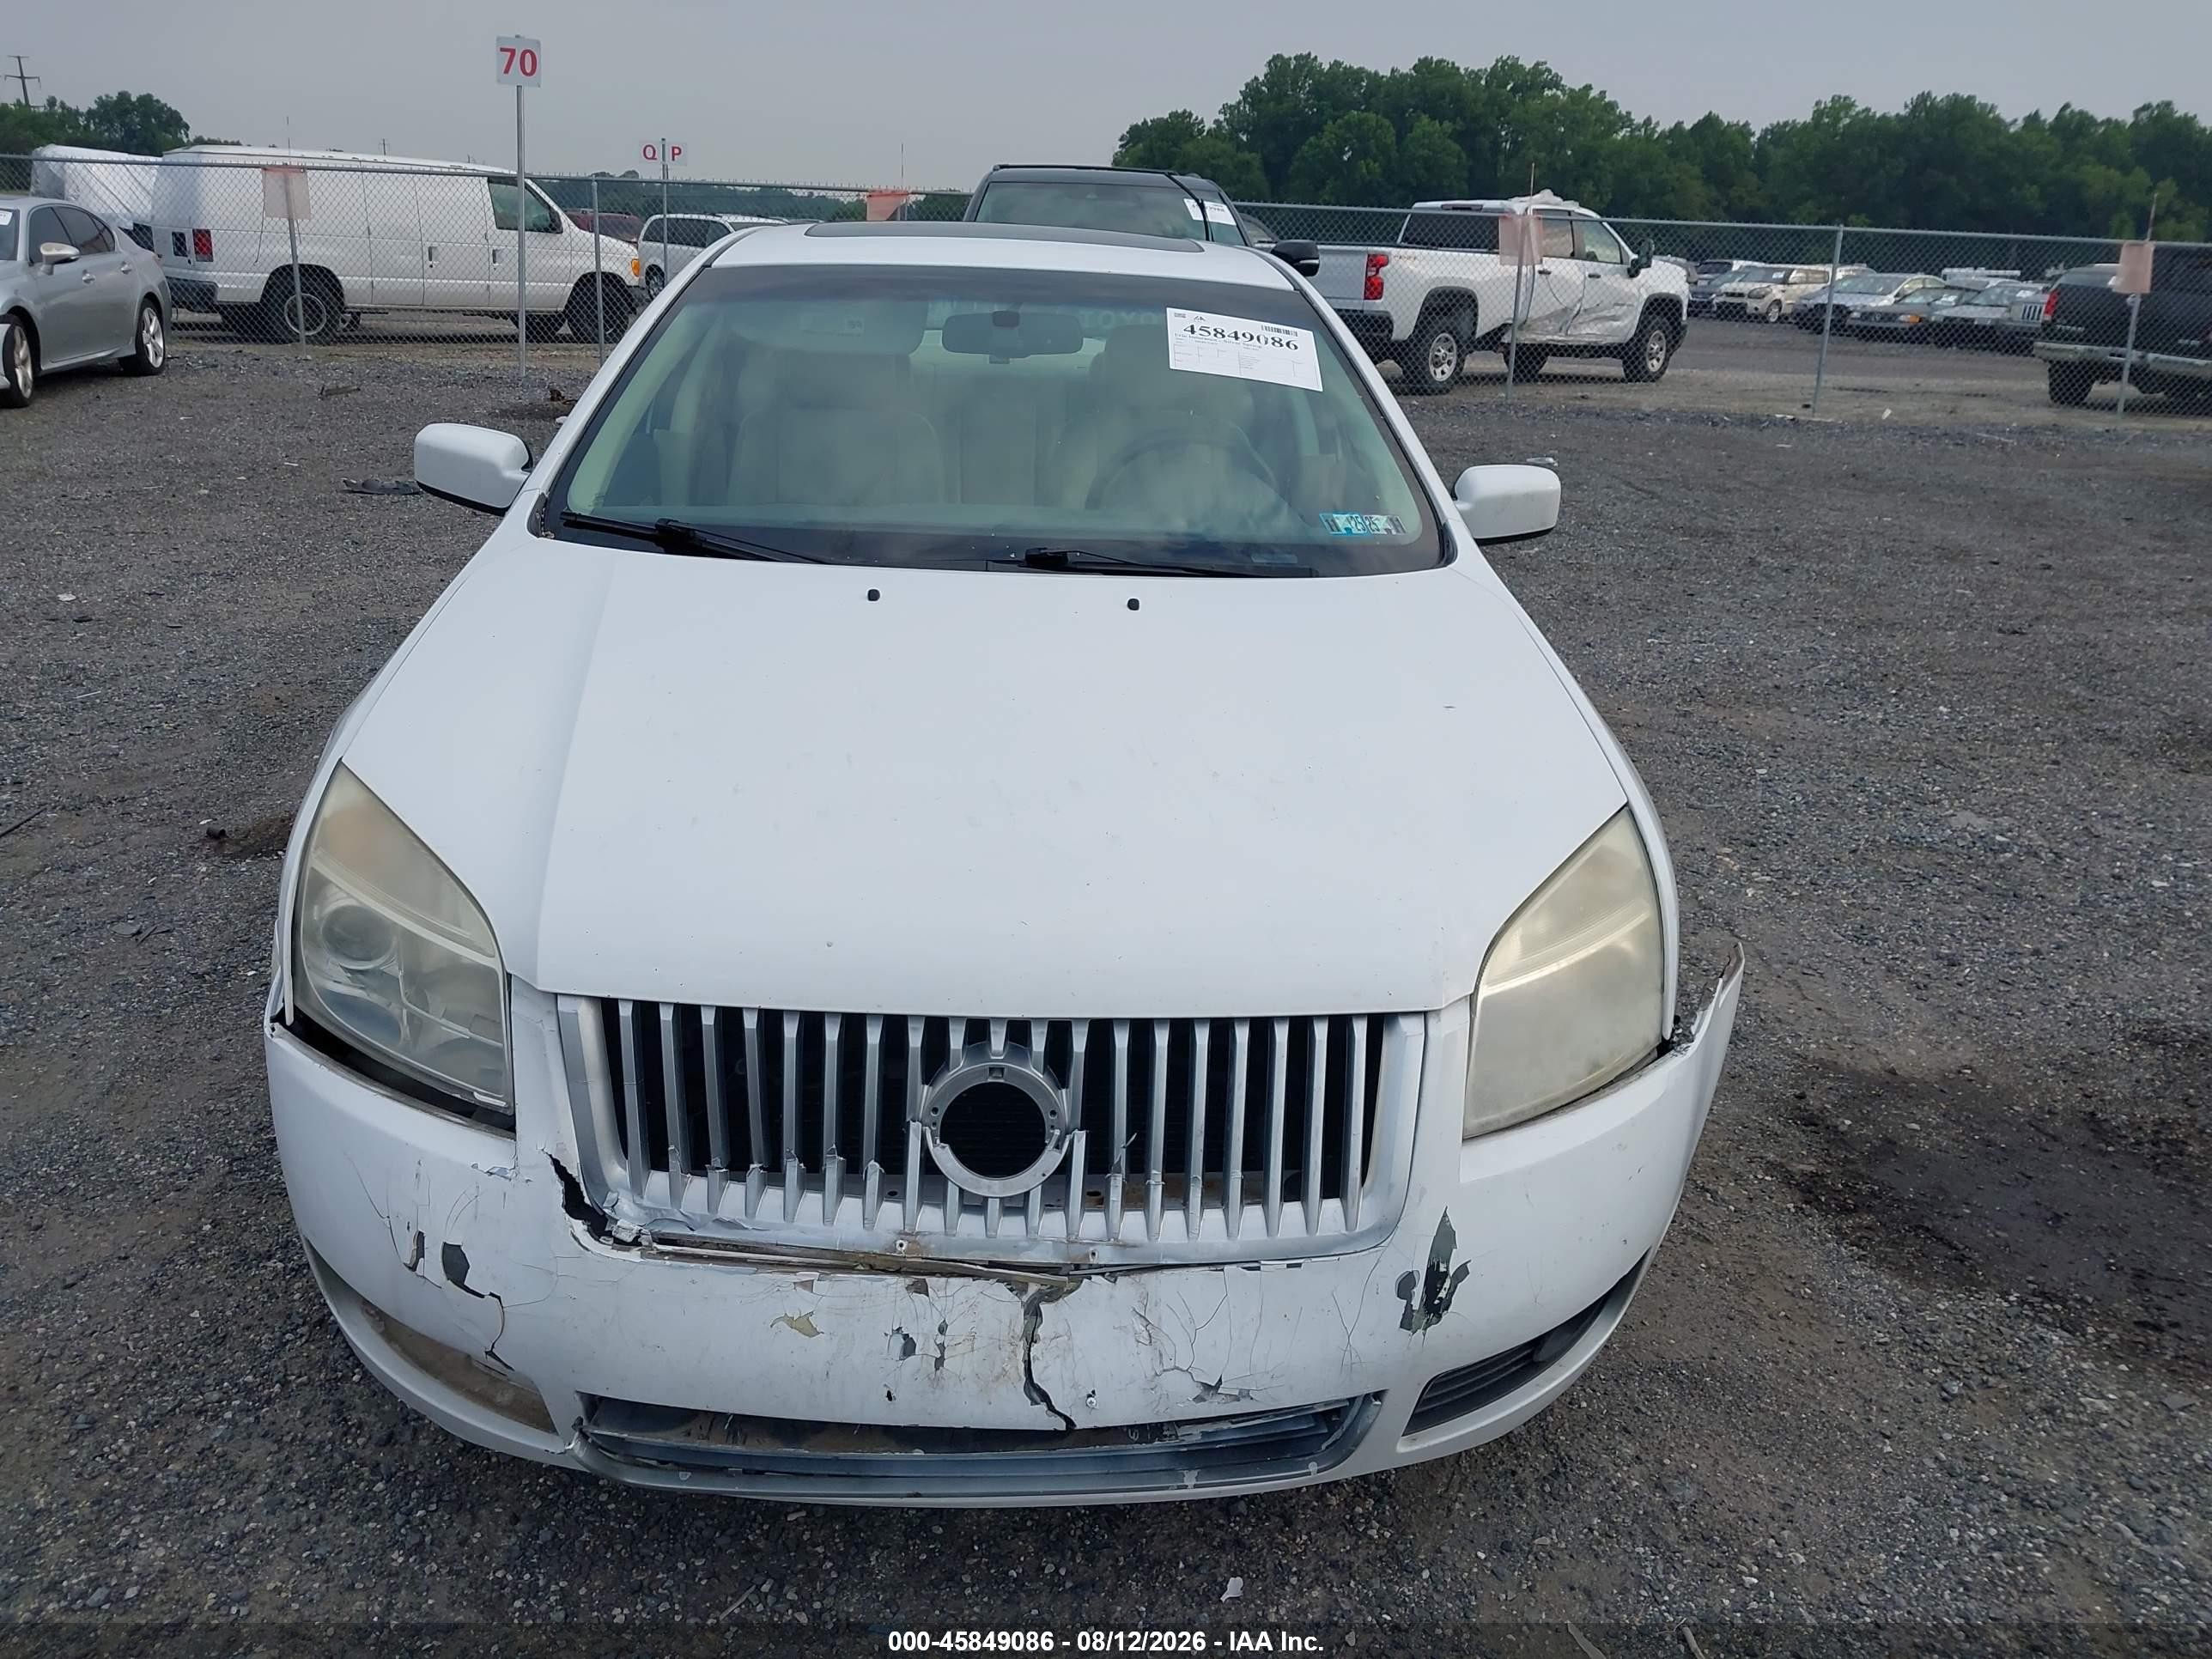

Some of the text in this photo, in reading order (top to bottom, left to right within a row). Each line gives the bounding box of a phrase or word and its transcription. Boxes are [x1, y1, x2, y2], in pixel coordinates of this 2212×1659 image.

[500, 47, 538, 76] 70
[642, 144, 657, 161] Q
[672, 146, 682, 161] P
[1183, 323, 1299, 351] 45849086
